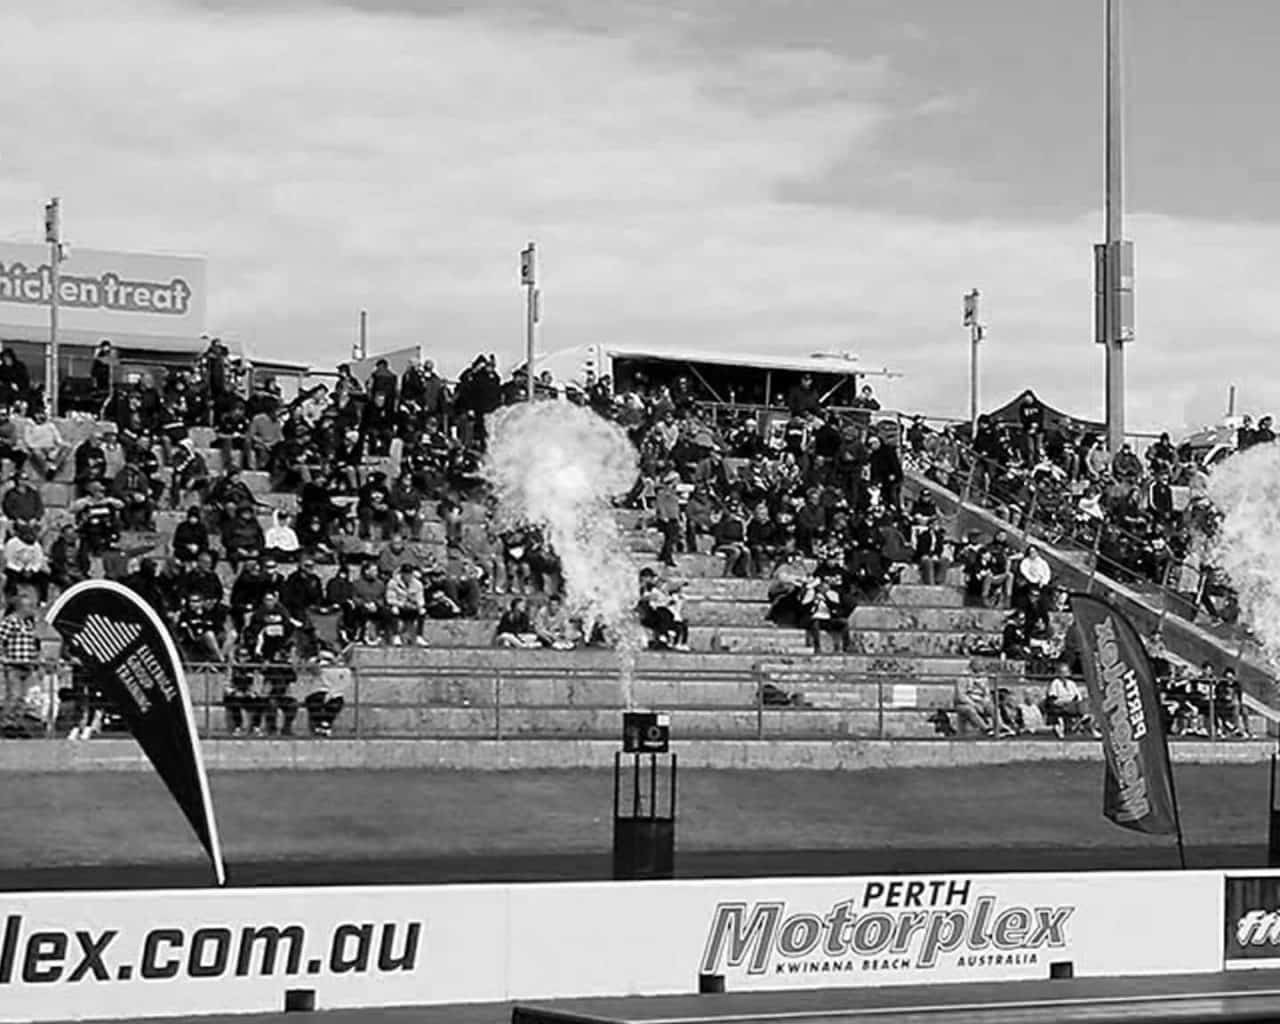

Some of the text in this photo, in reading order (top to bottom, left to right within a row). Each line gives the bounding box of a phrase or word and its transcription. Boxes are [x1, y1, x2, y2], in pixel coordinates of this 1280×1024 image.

[104, 276, 187, 311] treat
[863, 879, 972, 908] PERTH
[0, 914, 422, 984] lex.com.au
[701, 895, 1076, 975] Motorplex
[775, 957, 911, 974] KWINANA BEACH
[956, 953, 1039, 967] AUSTRALIA
